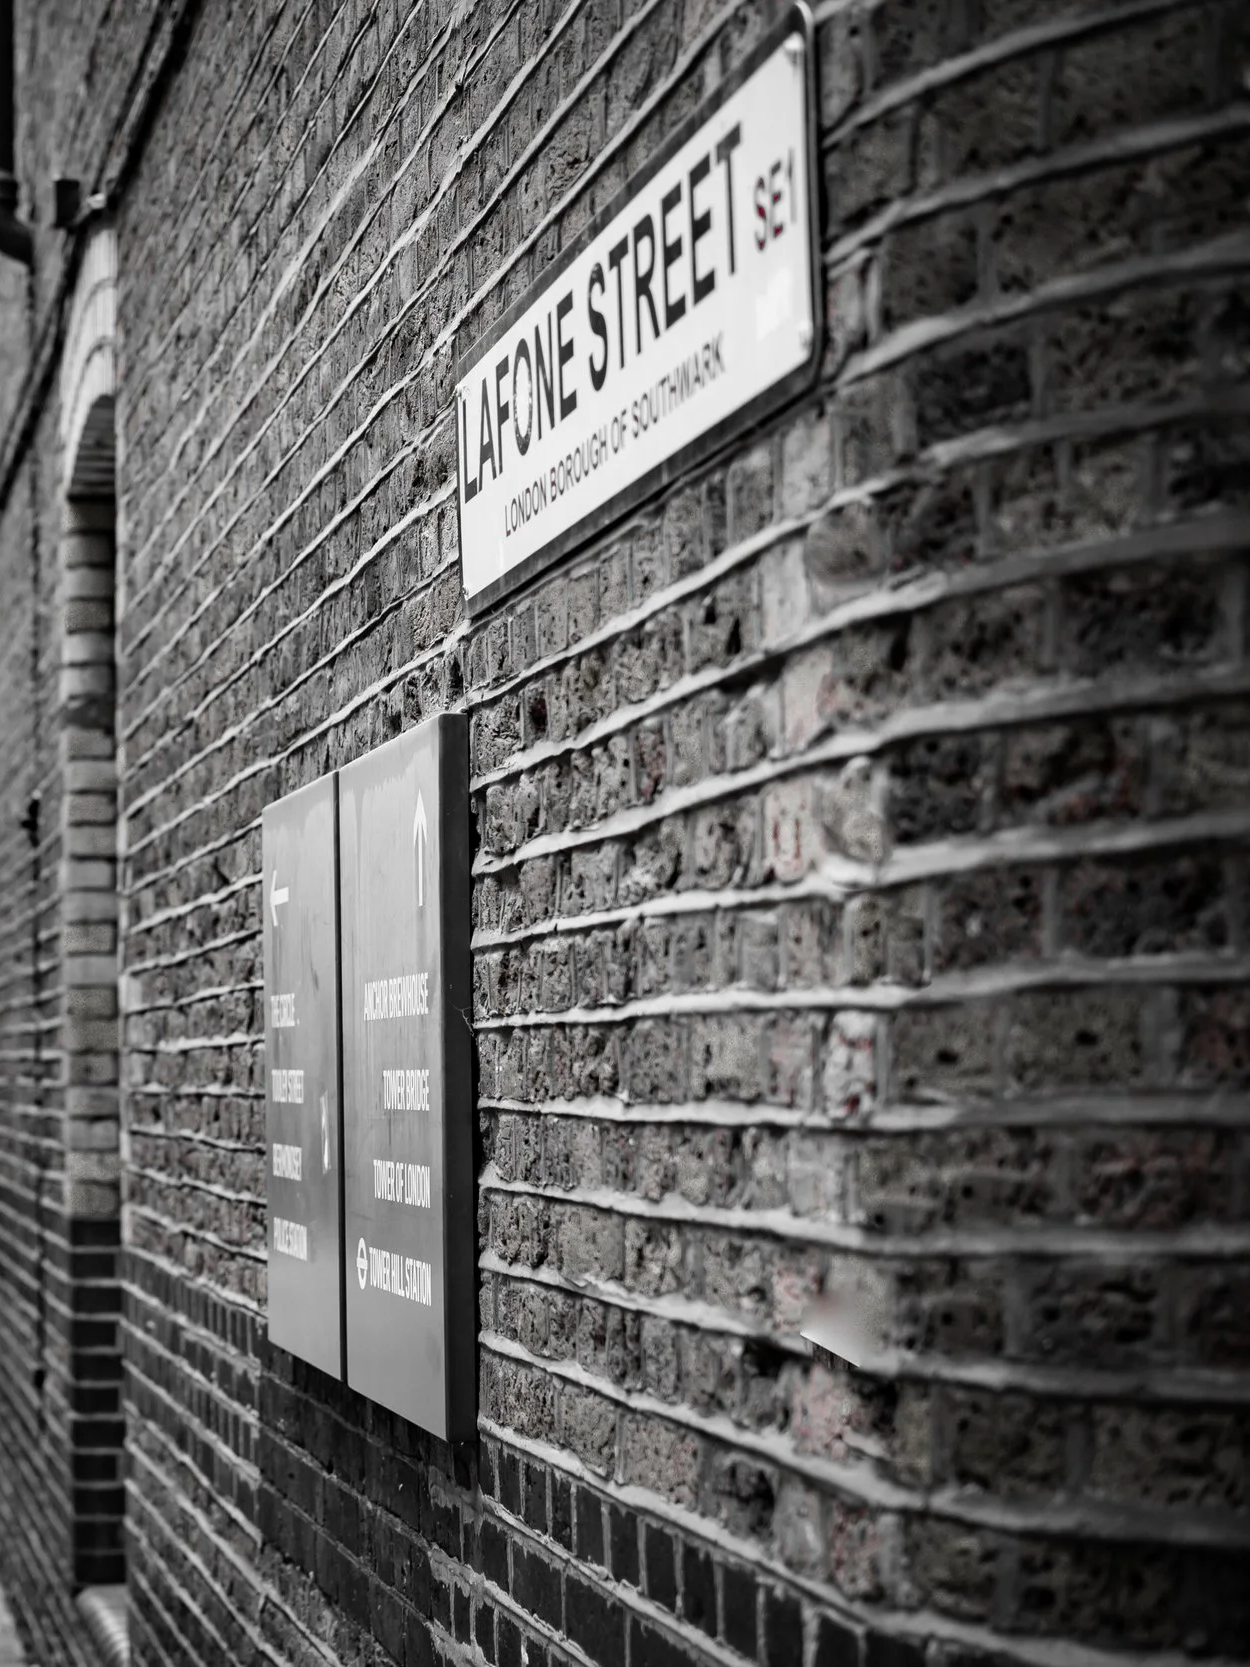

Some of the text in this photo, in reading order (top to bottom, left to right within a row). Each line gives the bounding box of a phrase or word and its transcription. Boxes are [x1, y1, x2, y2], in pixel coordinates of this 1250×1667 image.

[459, 121, 797, 504] LAFONE STREET SE1
[504, 330, 726, 538] LONDON BOROUGH OF SOUTHWARK
[363, 972, 429, 1021] ANCHOR BREWHOUSE
[382, 1069, 430, 1111] TOWER BRIDGE
[372, 1159, 431, 1209] TOWER OF LONDON
[368, 1246, 432, 1307] TOWER HILL STATION
